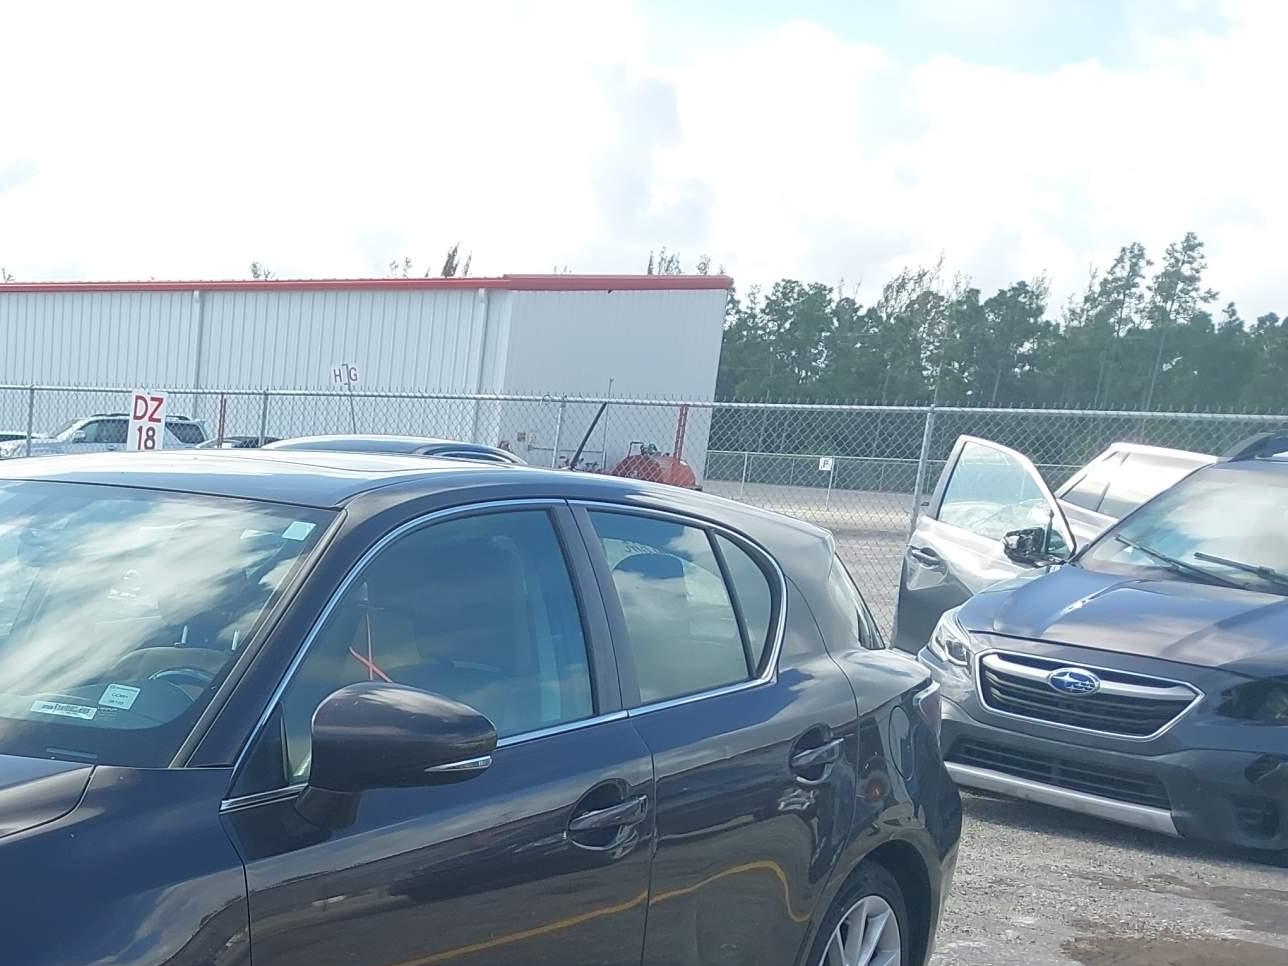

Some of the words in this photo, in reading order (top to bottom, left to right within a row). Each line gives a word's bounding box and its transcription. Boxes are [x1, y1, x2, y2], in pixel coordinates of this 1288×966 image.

[333, 368, 343, 383] H
[349, 366, 358, 382] G
[133, 395, 164, 423] DZ
[137, 425, 156, 451] 18
